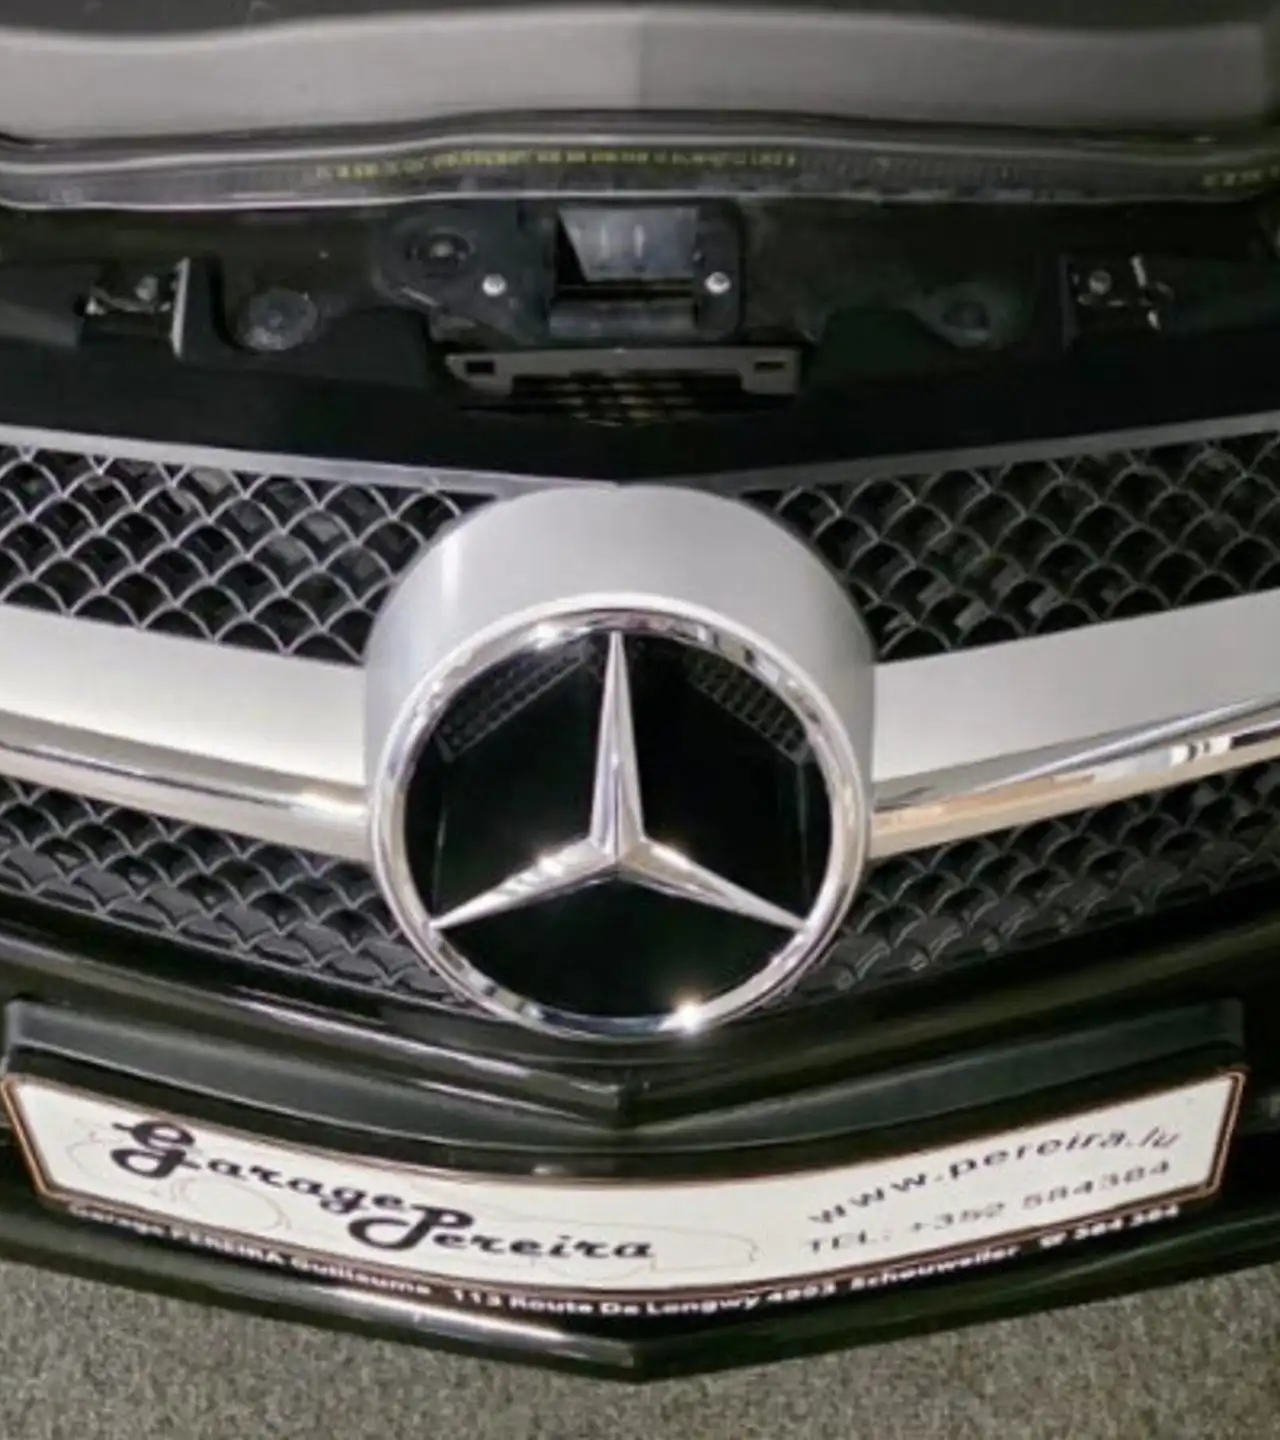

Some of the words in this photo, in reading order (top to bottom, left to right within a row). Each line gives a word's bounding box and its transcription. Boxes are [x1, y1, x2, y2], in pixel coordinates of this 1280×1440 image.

[111, 1120, 404, 1214] Garage
[348, 1203, 654, 1258] Pereira
[807, 1125, 1181, 1223] www.pereira.lu
[508, 1295, 594, 1315] Route
[600, 1300, 640, 1316] De
[646, 1295, 760, 1315] Longwy
